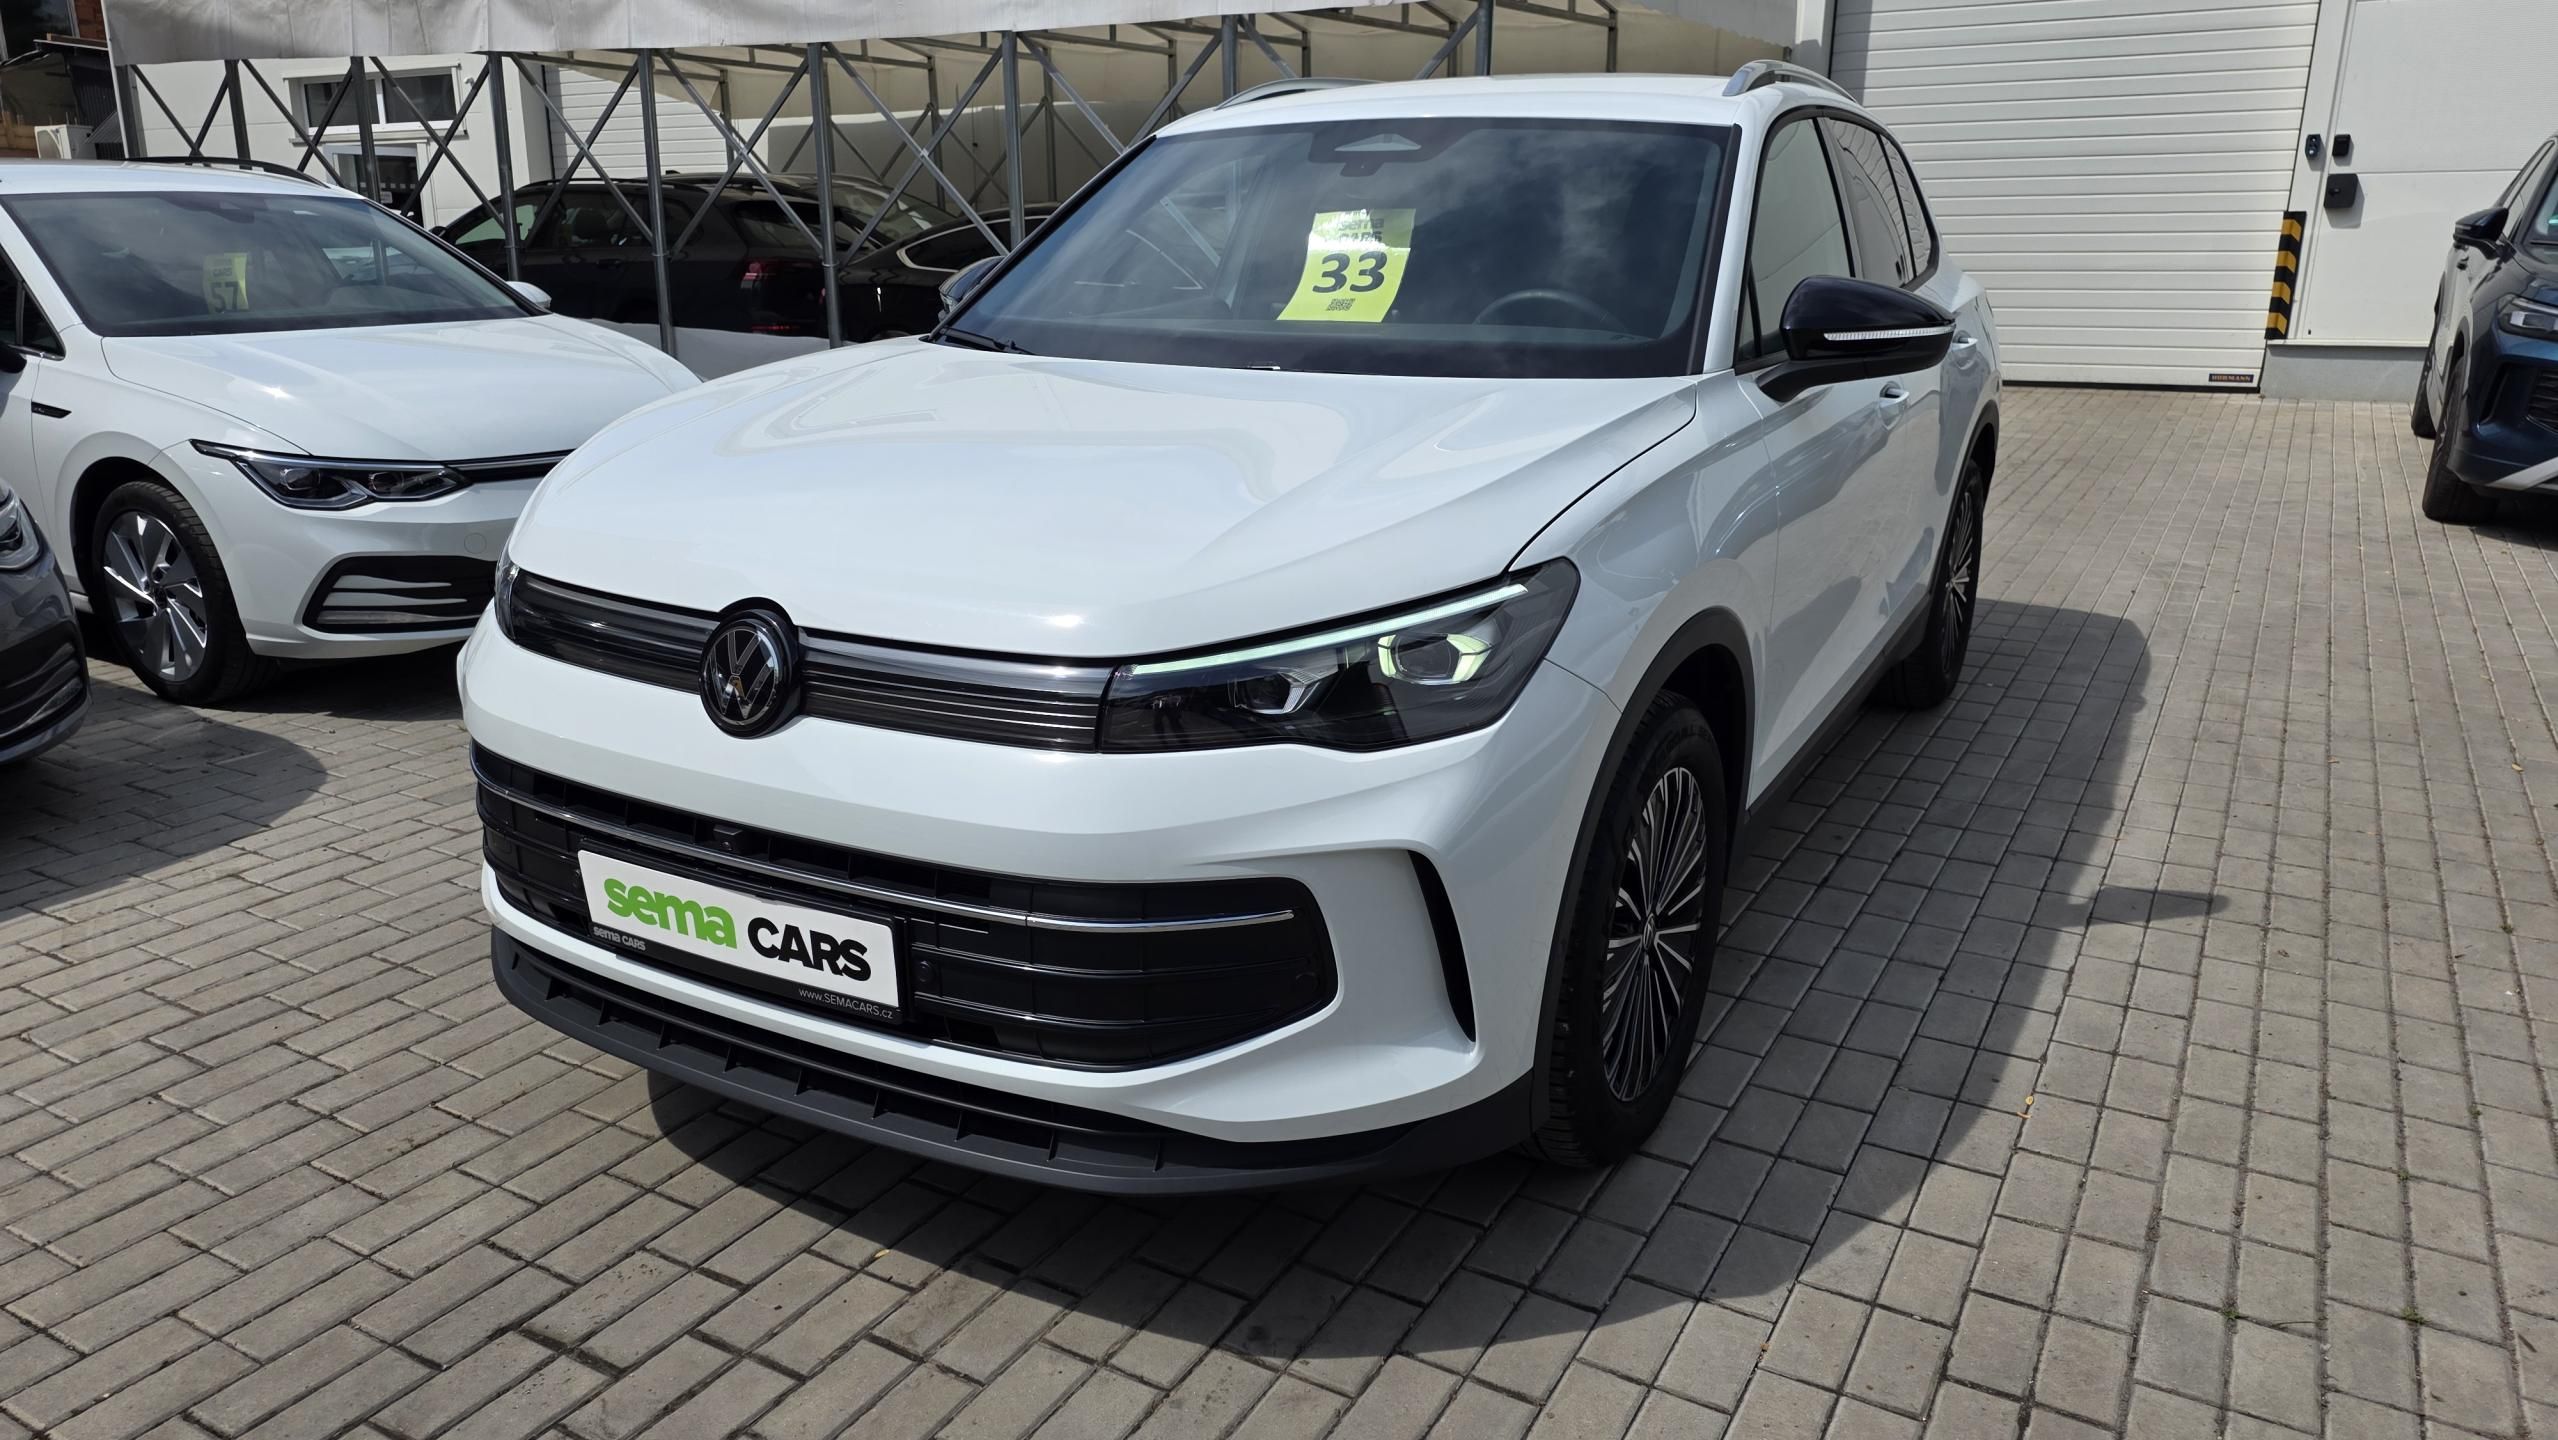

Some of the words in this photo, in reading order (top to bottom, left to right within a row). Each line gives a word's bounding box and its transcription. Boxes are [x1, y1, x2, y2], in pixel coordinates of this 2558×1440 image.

[1312, 251, 1388, 293] 33
[593, 926, 621, 943] sema
[622, 935, 646, 951] CARS
[604, 878, 737, 949] sema
[748, 917, 871, 981] CARS
[798, 988, 894, 1019] www.SEMACARS.cz
